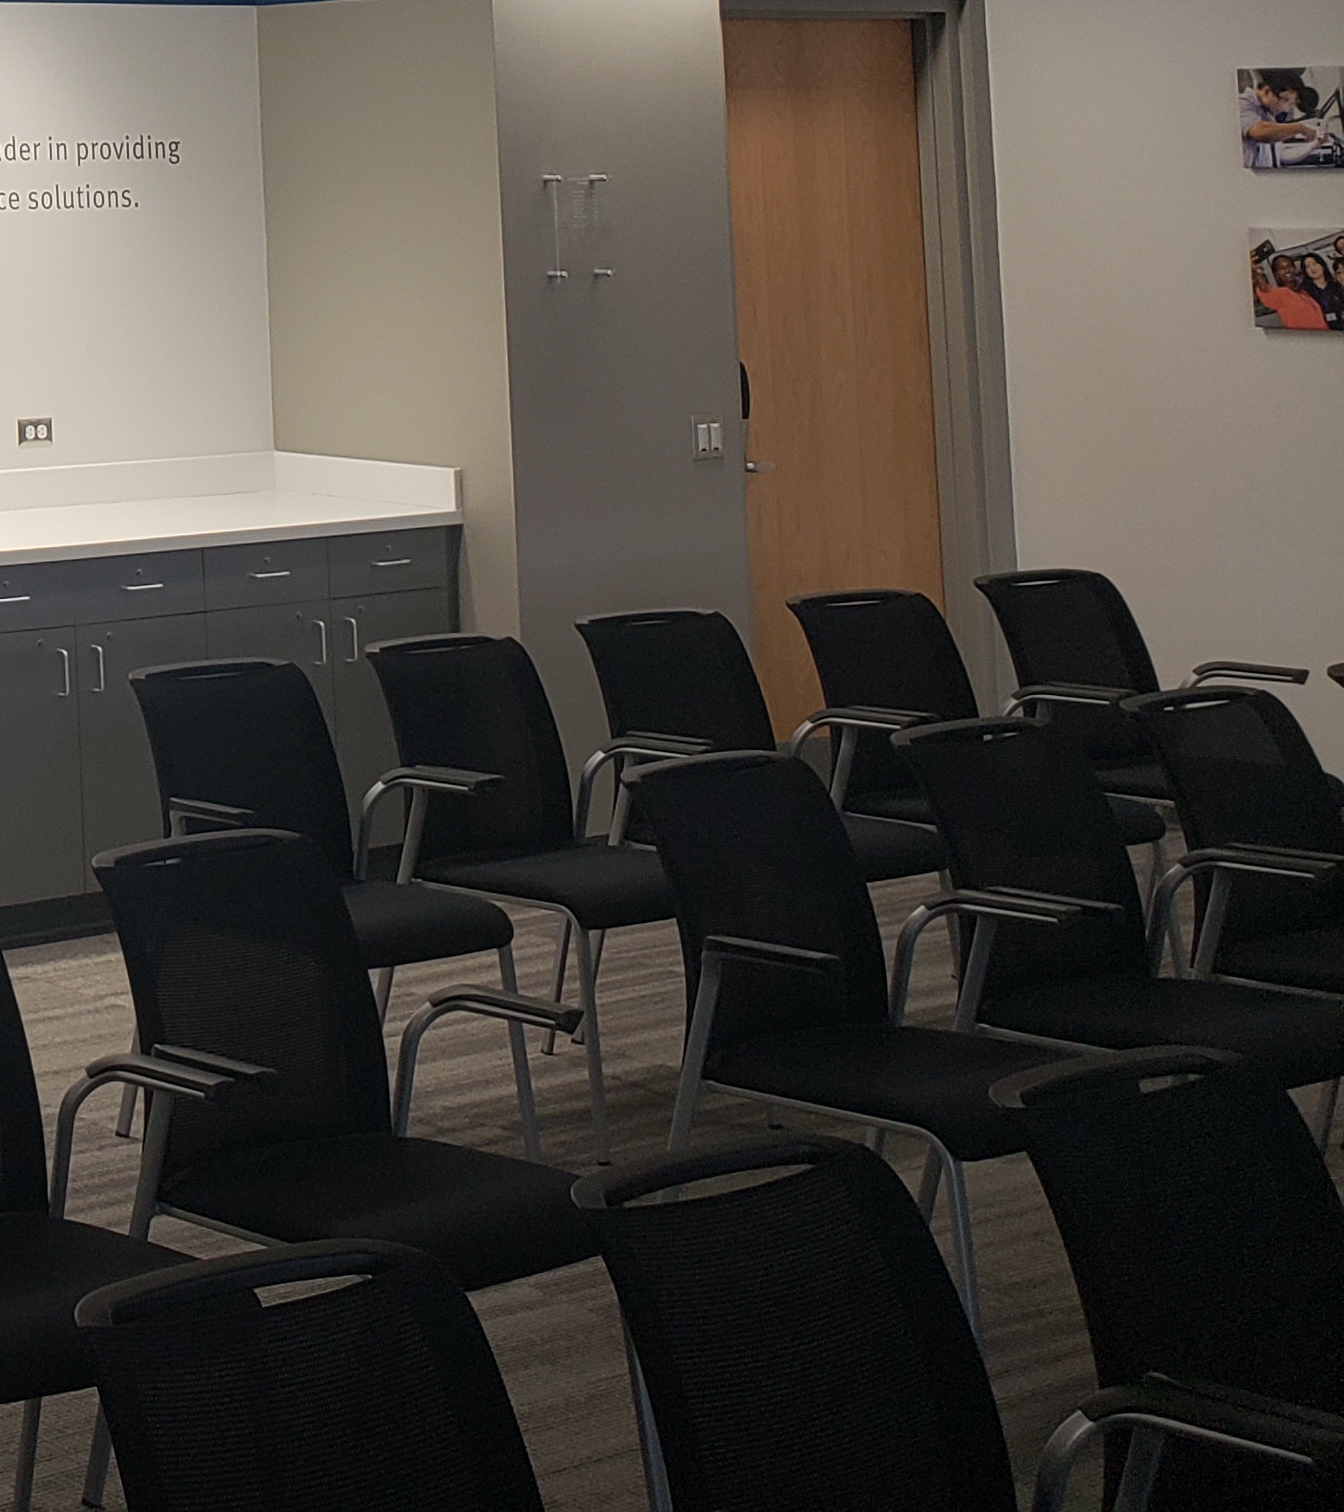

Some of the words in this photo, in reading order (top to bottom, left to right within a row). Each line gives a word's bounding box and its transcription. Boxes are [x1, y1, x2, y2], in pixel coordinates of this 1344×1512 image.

[48, 136, 68, 161] in
[76, 134, 181, 167] providing
[28, 183, 139, 210] solutions.
